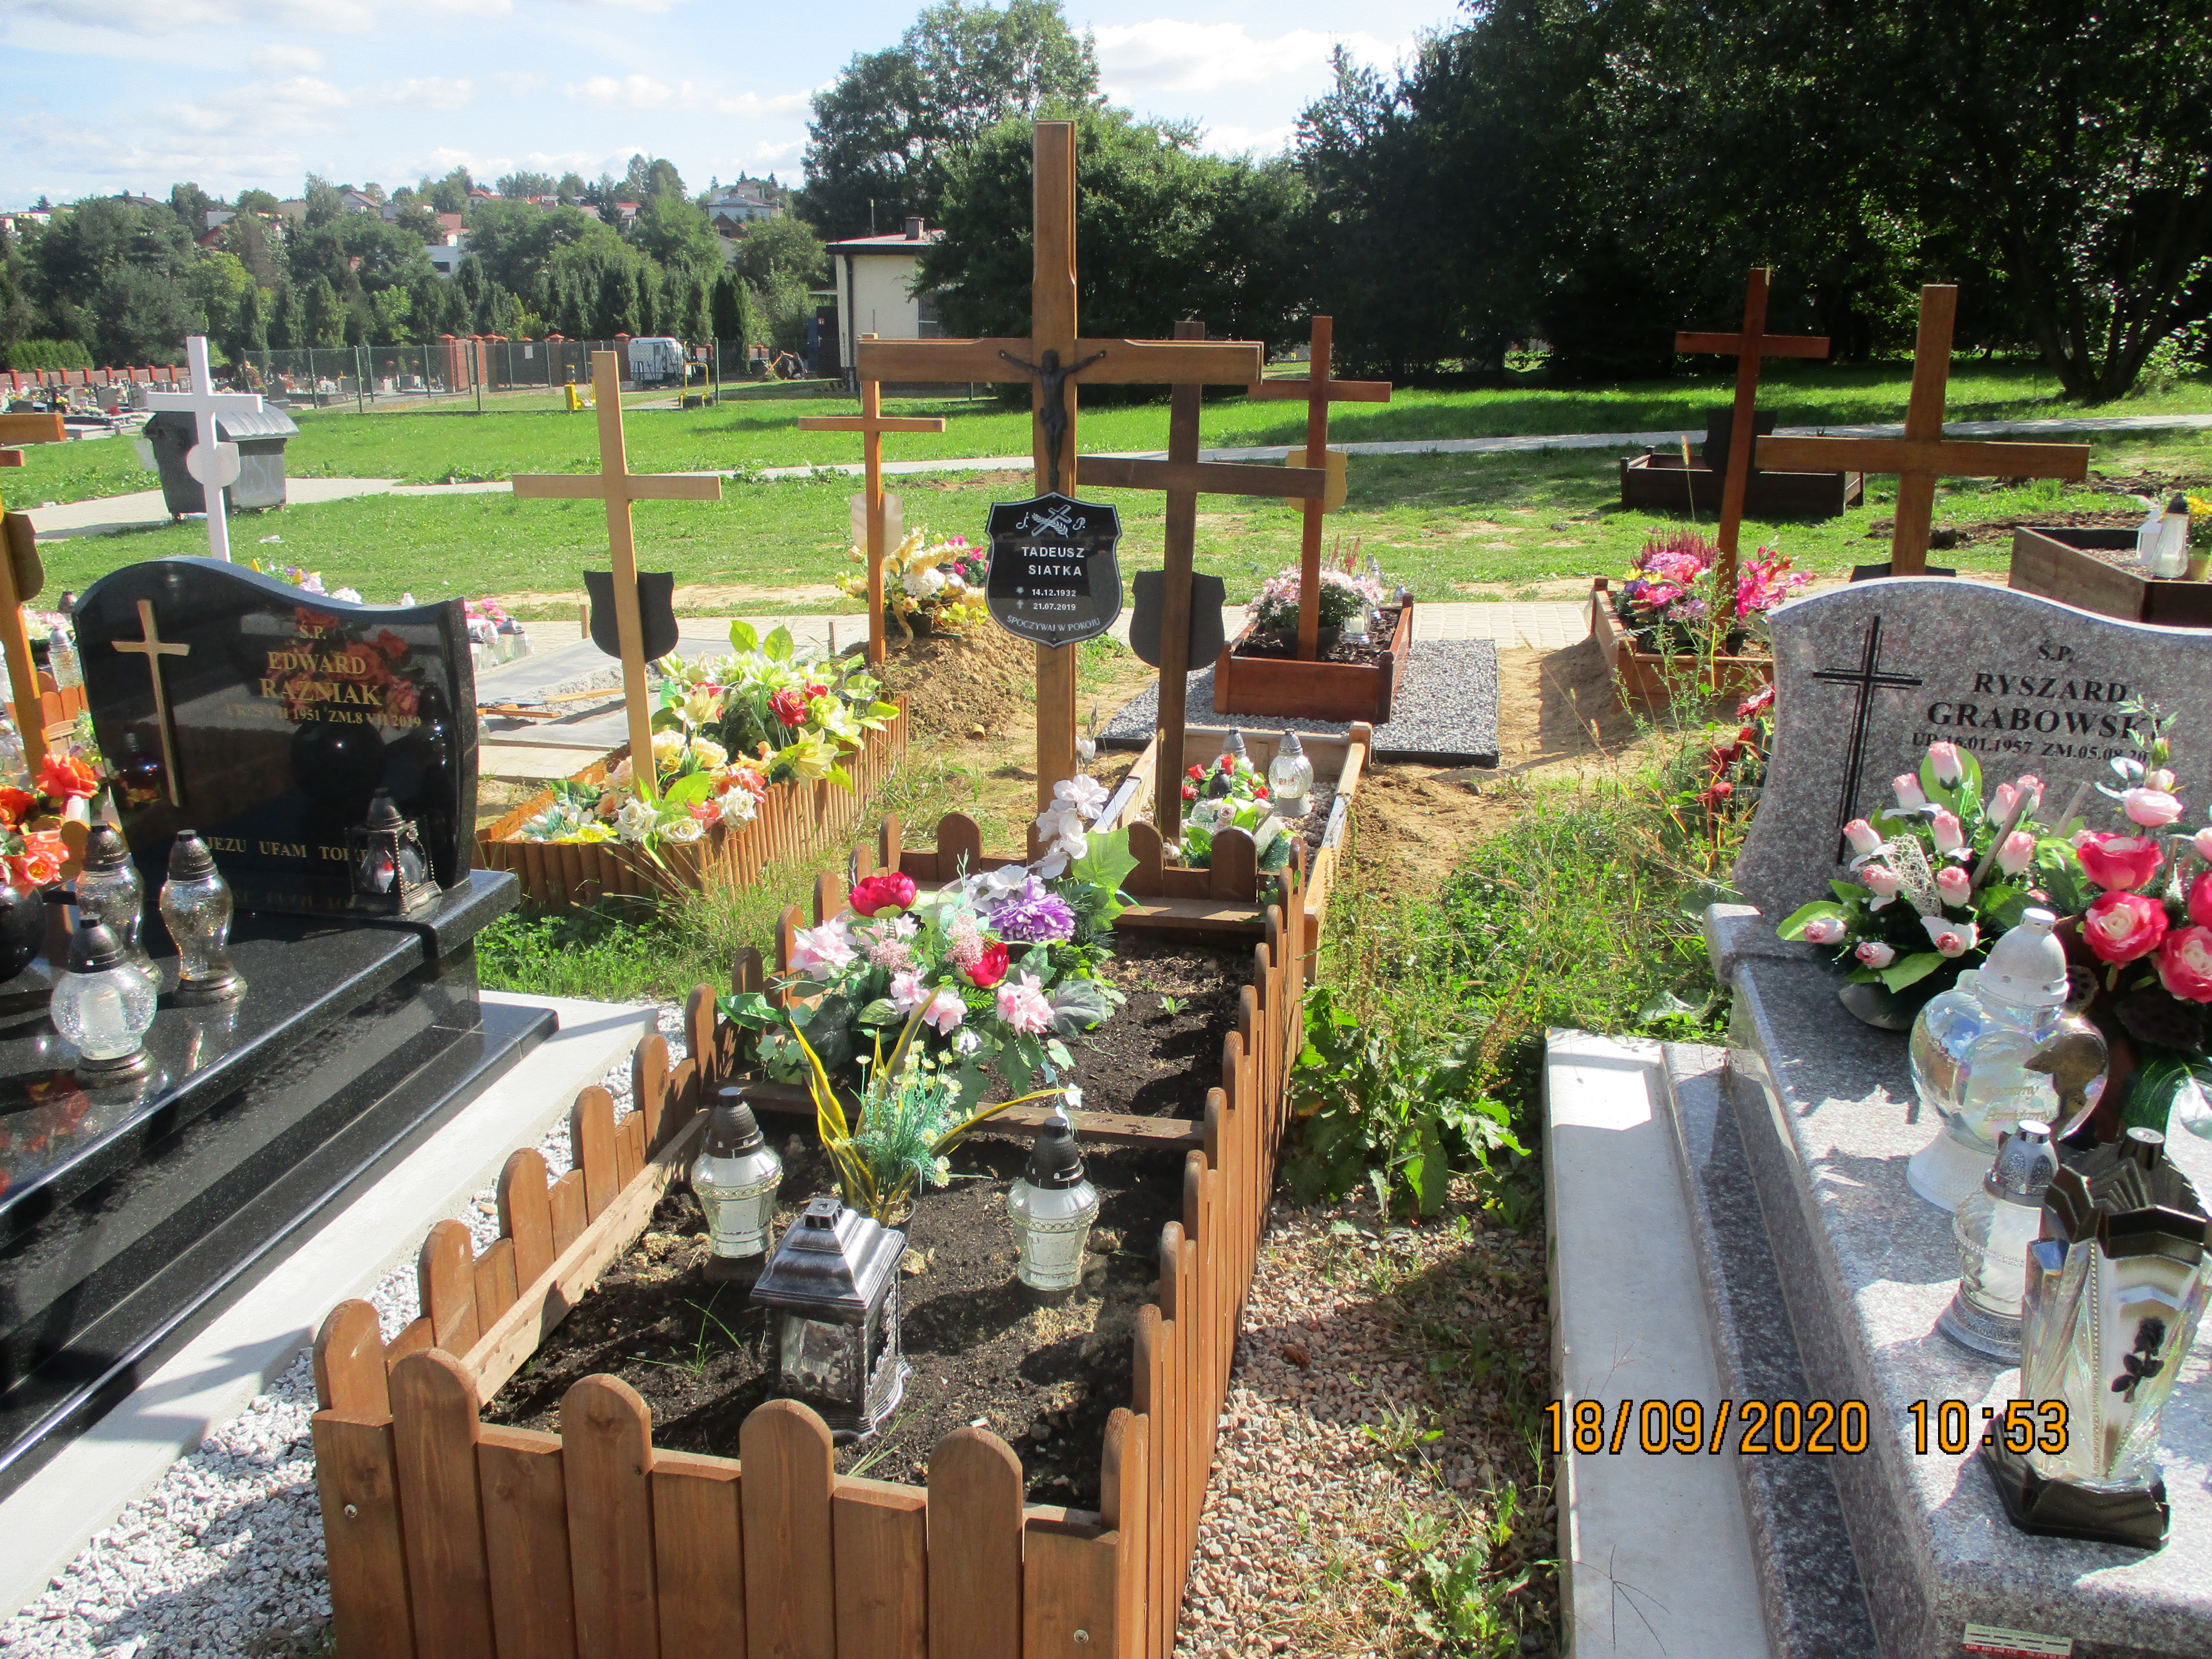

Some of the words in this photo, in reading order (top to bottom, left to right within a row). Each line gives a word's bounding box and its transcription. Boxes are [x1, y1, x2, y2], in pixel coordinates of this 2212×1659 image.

[1021, 547, 1085, 559] TADEUSZ
[1028, 565, 1082, 576] SIATKA
[1032, 589, 1076, 597] 14.12.1932
[1033, 603, 1076, 611] 21.07.2019
[1006, 615, 1056, 632] SPOCZYWAJ
[1068, 617, 1100, 632] POKOJU
[267, 651, 366, 675] EDWARD
[1974, 672, 2127, 702] RYSZARD
[294, 708, 321, 722] 1951
[392, 714, 422, 728] 2019
[206, 837, 246, 852] JEZU
[258, 841, 307, 858] UFAM
